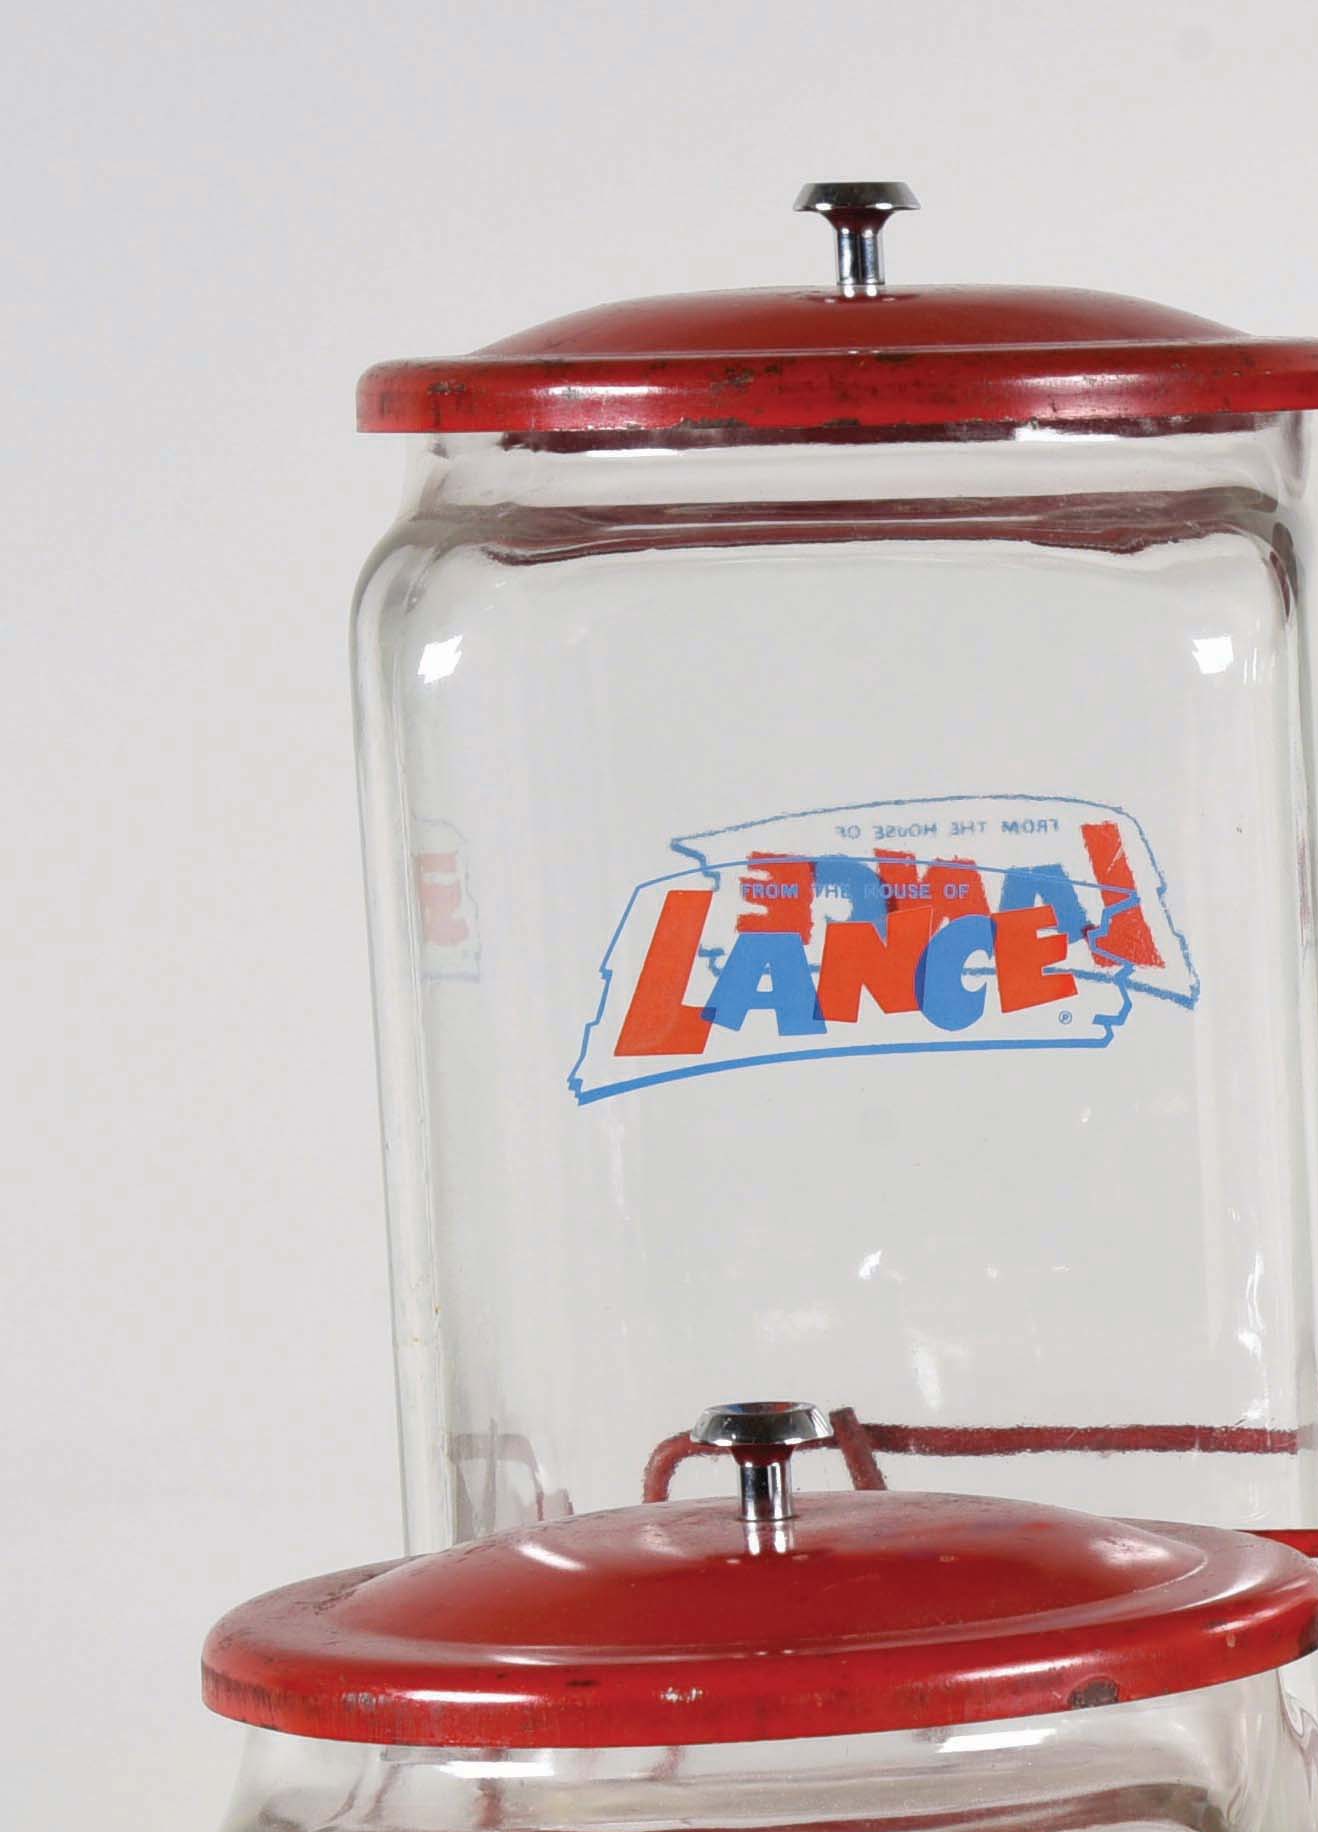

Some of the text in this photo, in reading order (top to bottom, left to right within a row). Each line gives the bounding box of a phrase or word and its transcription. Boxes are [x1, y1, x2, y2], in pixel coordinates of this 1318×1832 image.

[741, 883, 969, 899] FROM THE HOUSE OF
[614, 889, 1079, 1057] LANCE
